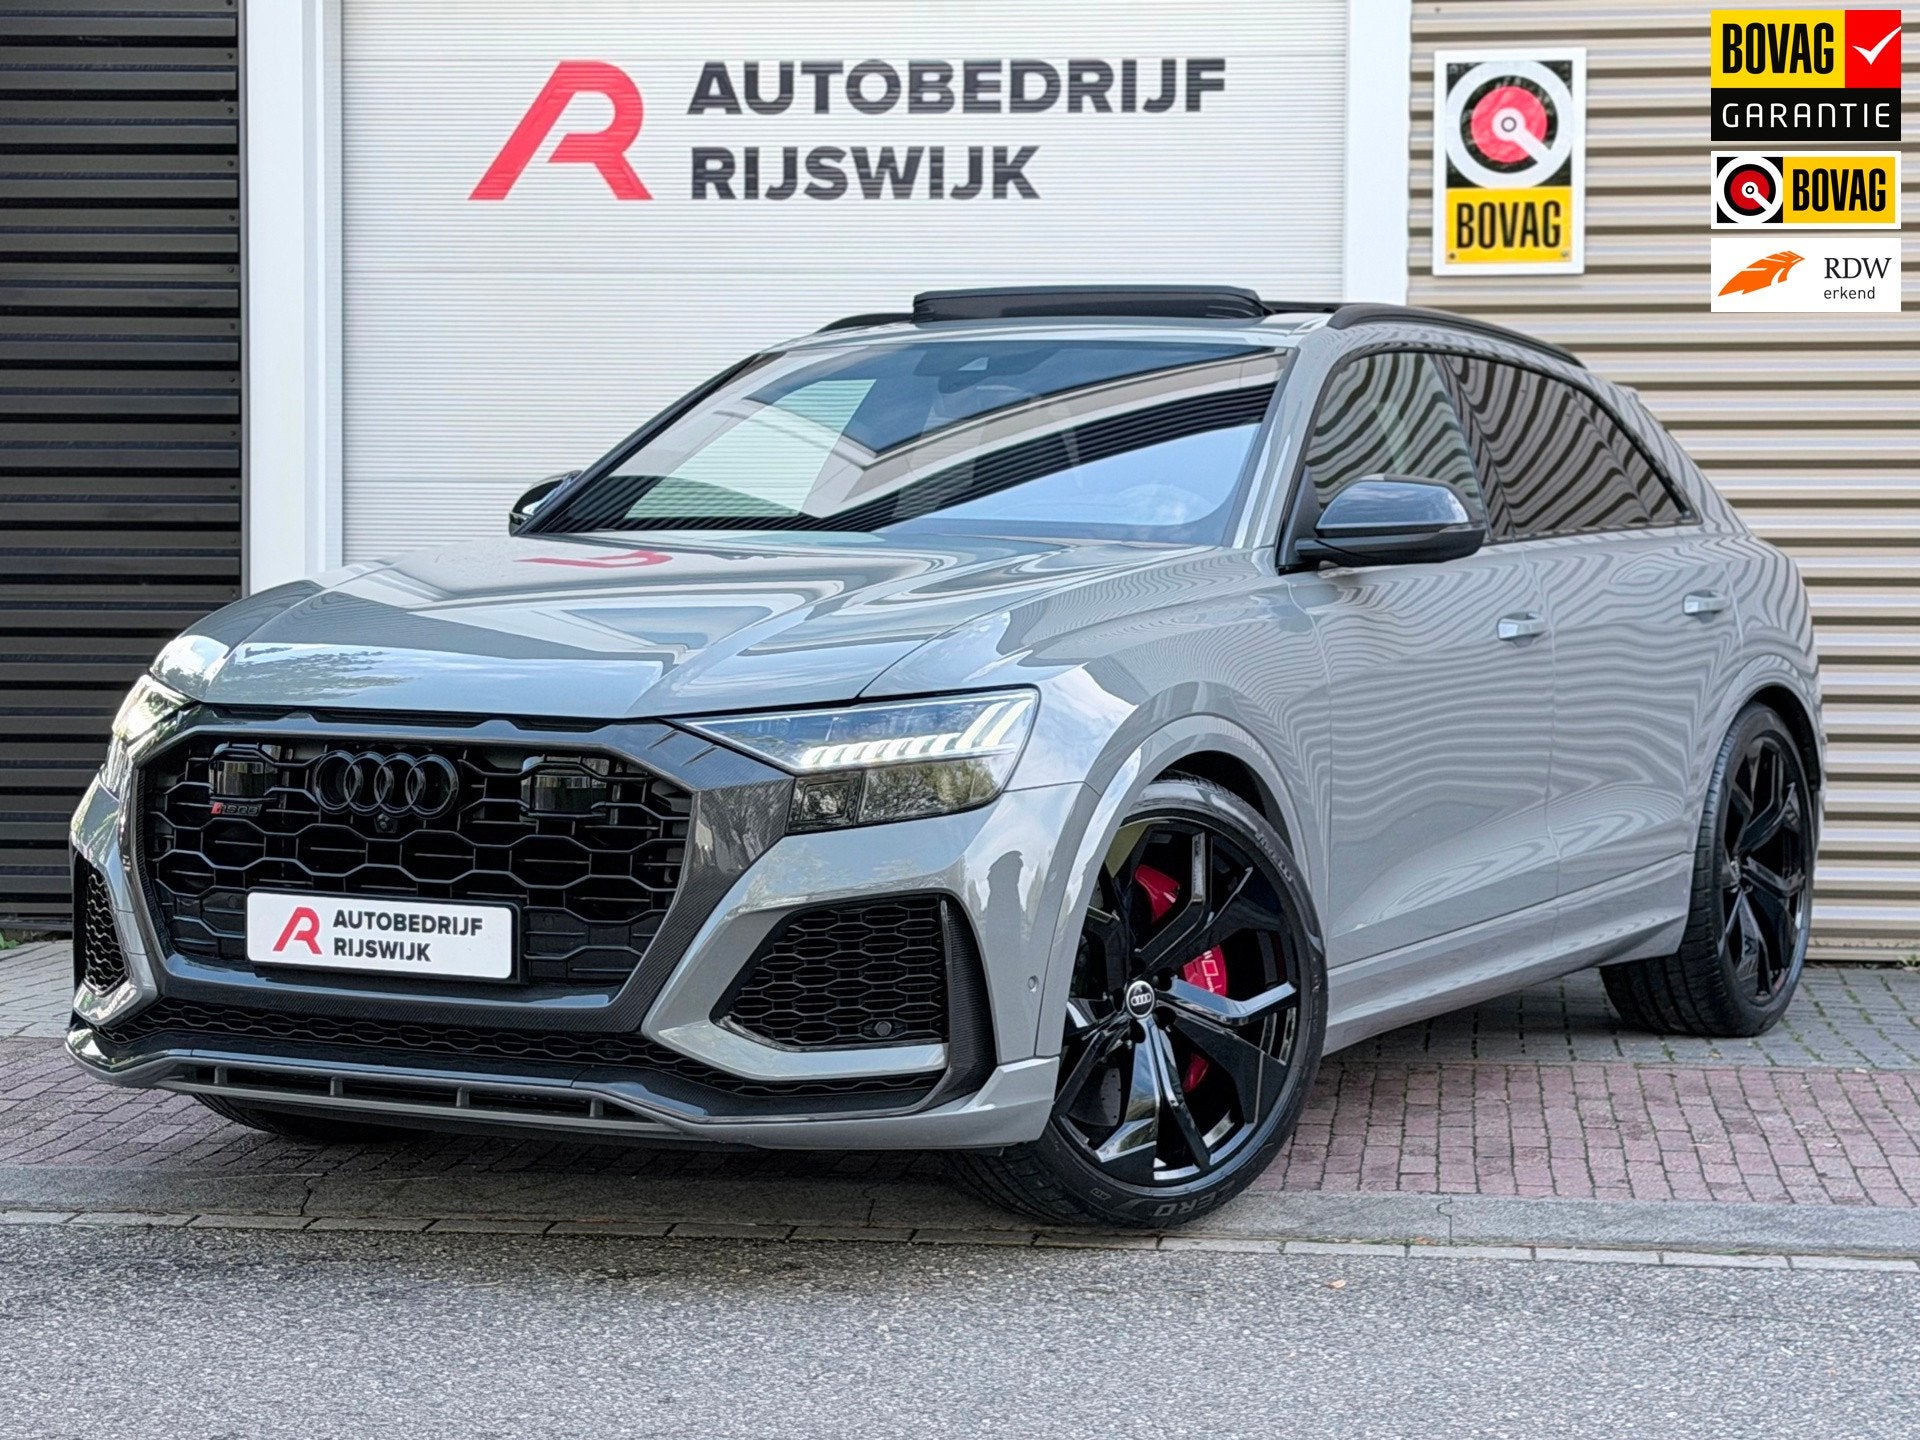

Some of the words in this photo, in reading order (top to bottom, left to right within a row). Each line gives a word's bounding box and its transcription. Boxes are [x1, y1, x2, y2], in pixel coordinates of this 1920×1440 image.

[687, 58, 1226, 115] AUTOBEDRIJF
[691, 146, 1040, 200] RIJSWIJK
[1456, 200, 1561, 249] BOVAG
[333, 909, 483, 937] AUTOBEDRIJF
[333, 937, 432, 963] RIJSWIJK
